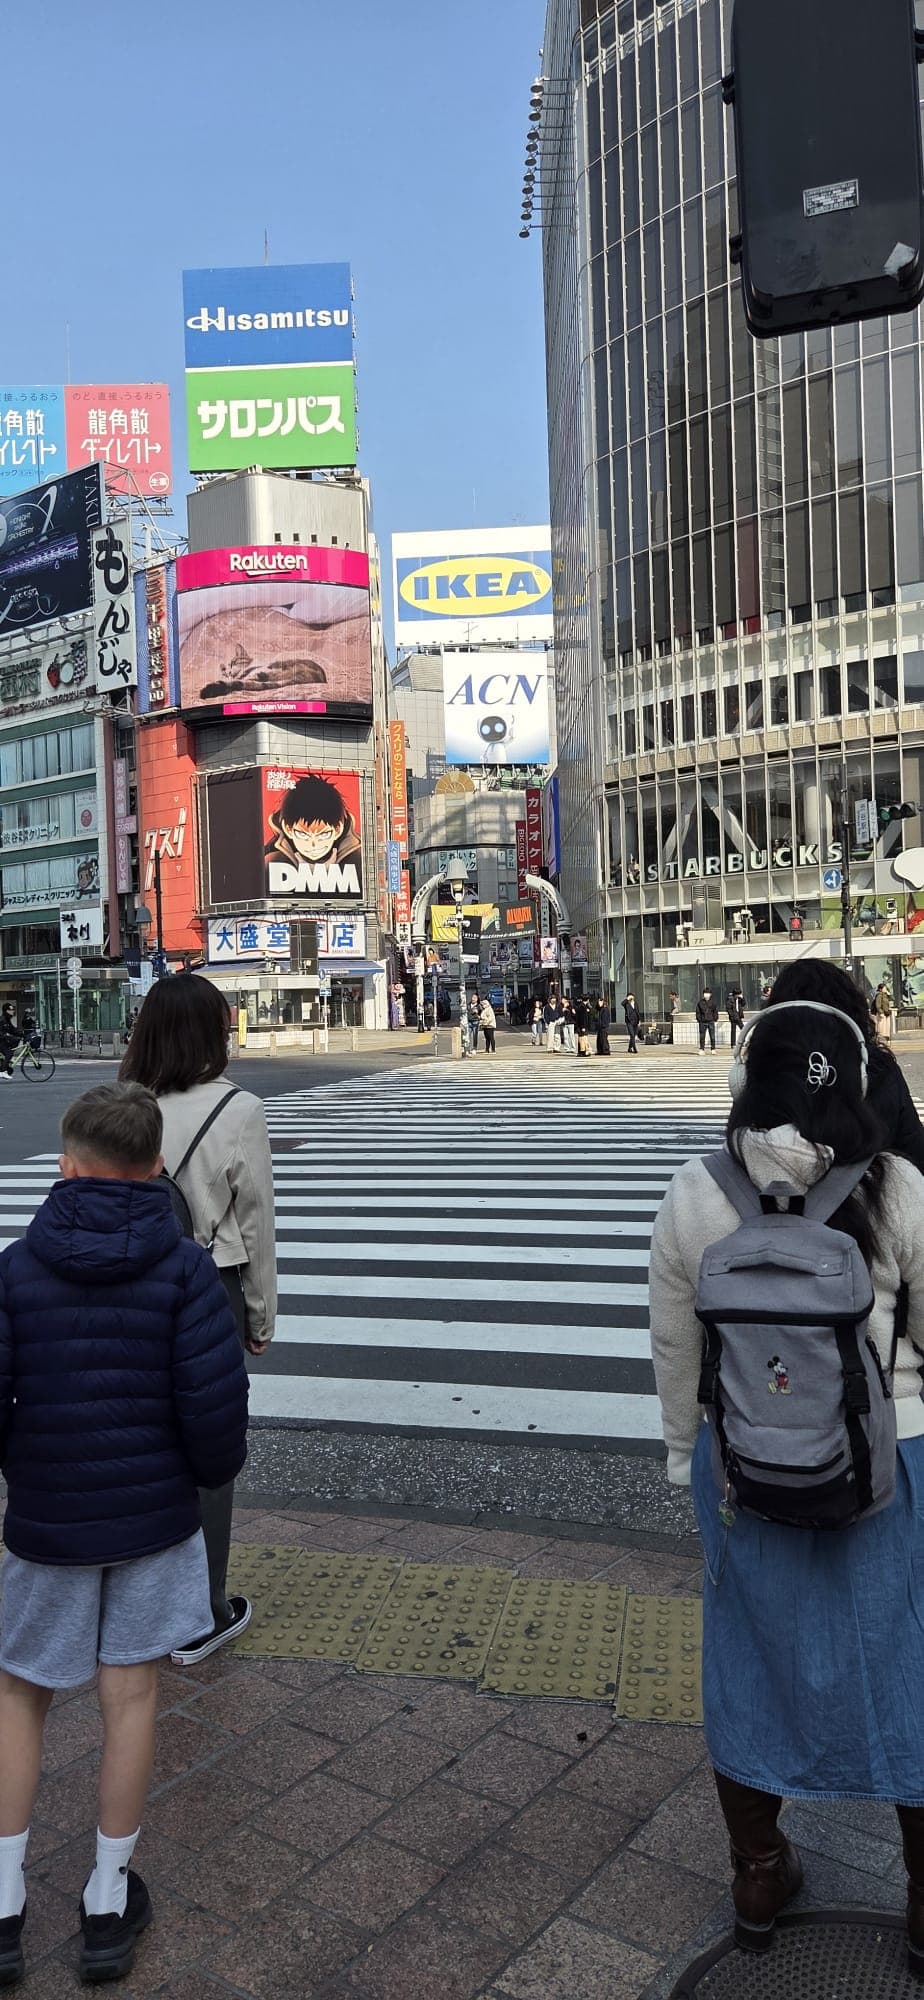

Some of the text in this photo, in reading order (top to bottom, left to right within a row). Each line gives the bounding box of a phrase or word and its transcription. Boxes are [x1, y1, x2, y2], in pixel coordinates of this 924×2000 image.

[186, 306, 349, 333] Hisamitsu
[87, 408, 150, 435] 龍角散
[197, 395, 345, 440] サロンパス
[80, 438, 162, 464] ダイレクト
[230, 551, 308, 571] Rakuten
[413, 571, 541, 601] IKEA
[94, 526, 133, 683] もんじゃ
[446, 674, 545, 706] ACN
[251, 702, 297, 712] Rakuten Vision
[393, 724, 403, 801] クスリのことなら
[3, 825, 60, 845] 渋谷クリニック
[527, 797, 542, 858] カラオケ
[144, 806, 187, 891] クスリ
[647, 841, 844, 882] STARBUCKS
[268, 862, 361, 894] DMM
[2, 889, 76, 906] ジャスミンレディースクリニック
[216, 922, 356, 952] 大盛堂店
